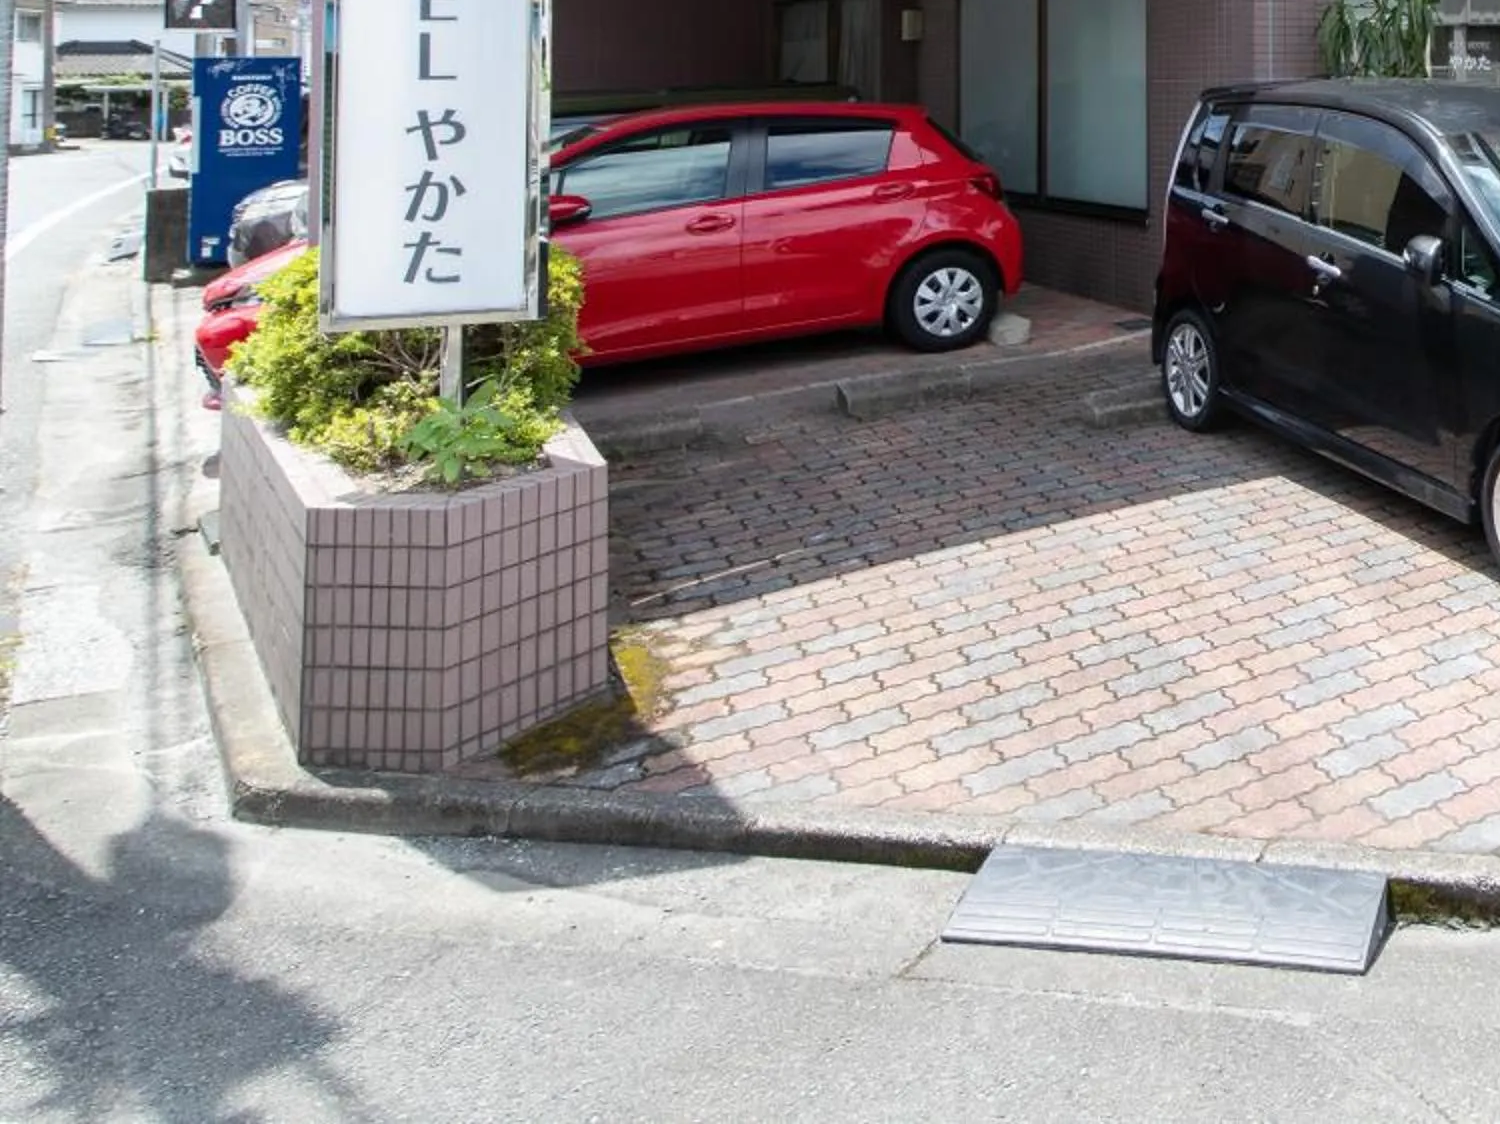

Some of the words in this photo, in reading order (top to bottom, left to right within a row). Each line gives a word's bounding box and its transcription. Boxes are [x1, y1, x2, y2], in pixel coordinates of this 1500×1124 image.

[218, 127, 284, 146] BOSS
[403, 108, 467, 284] やかた
